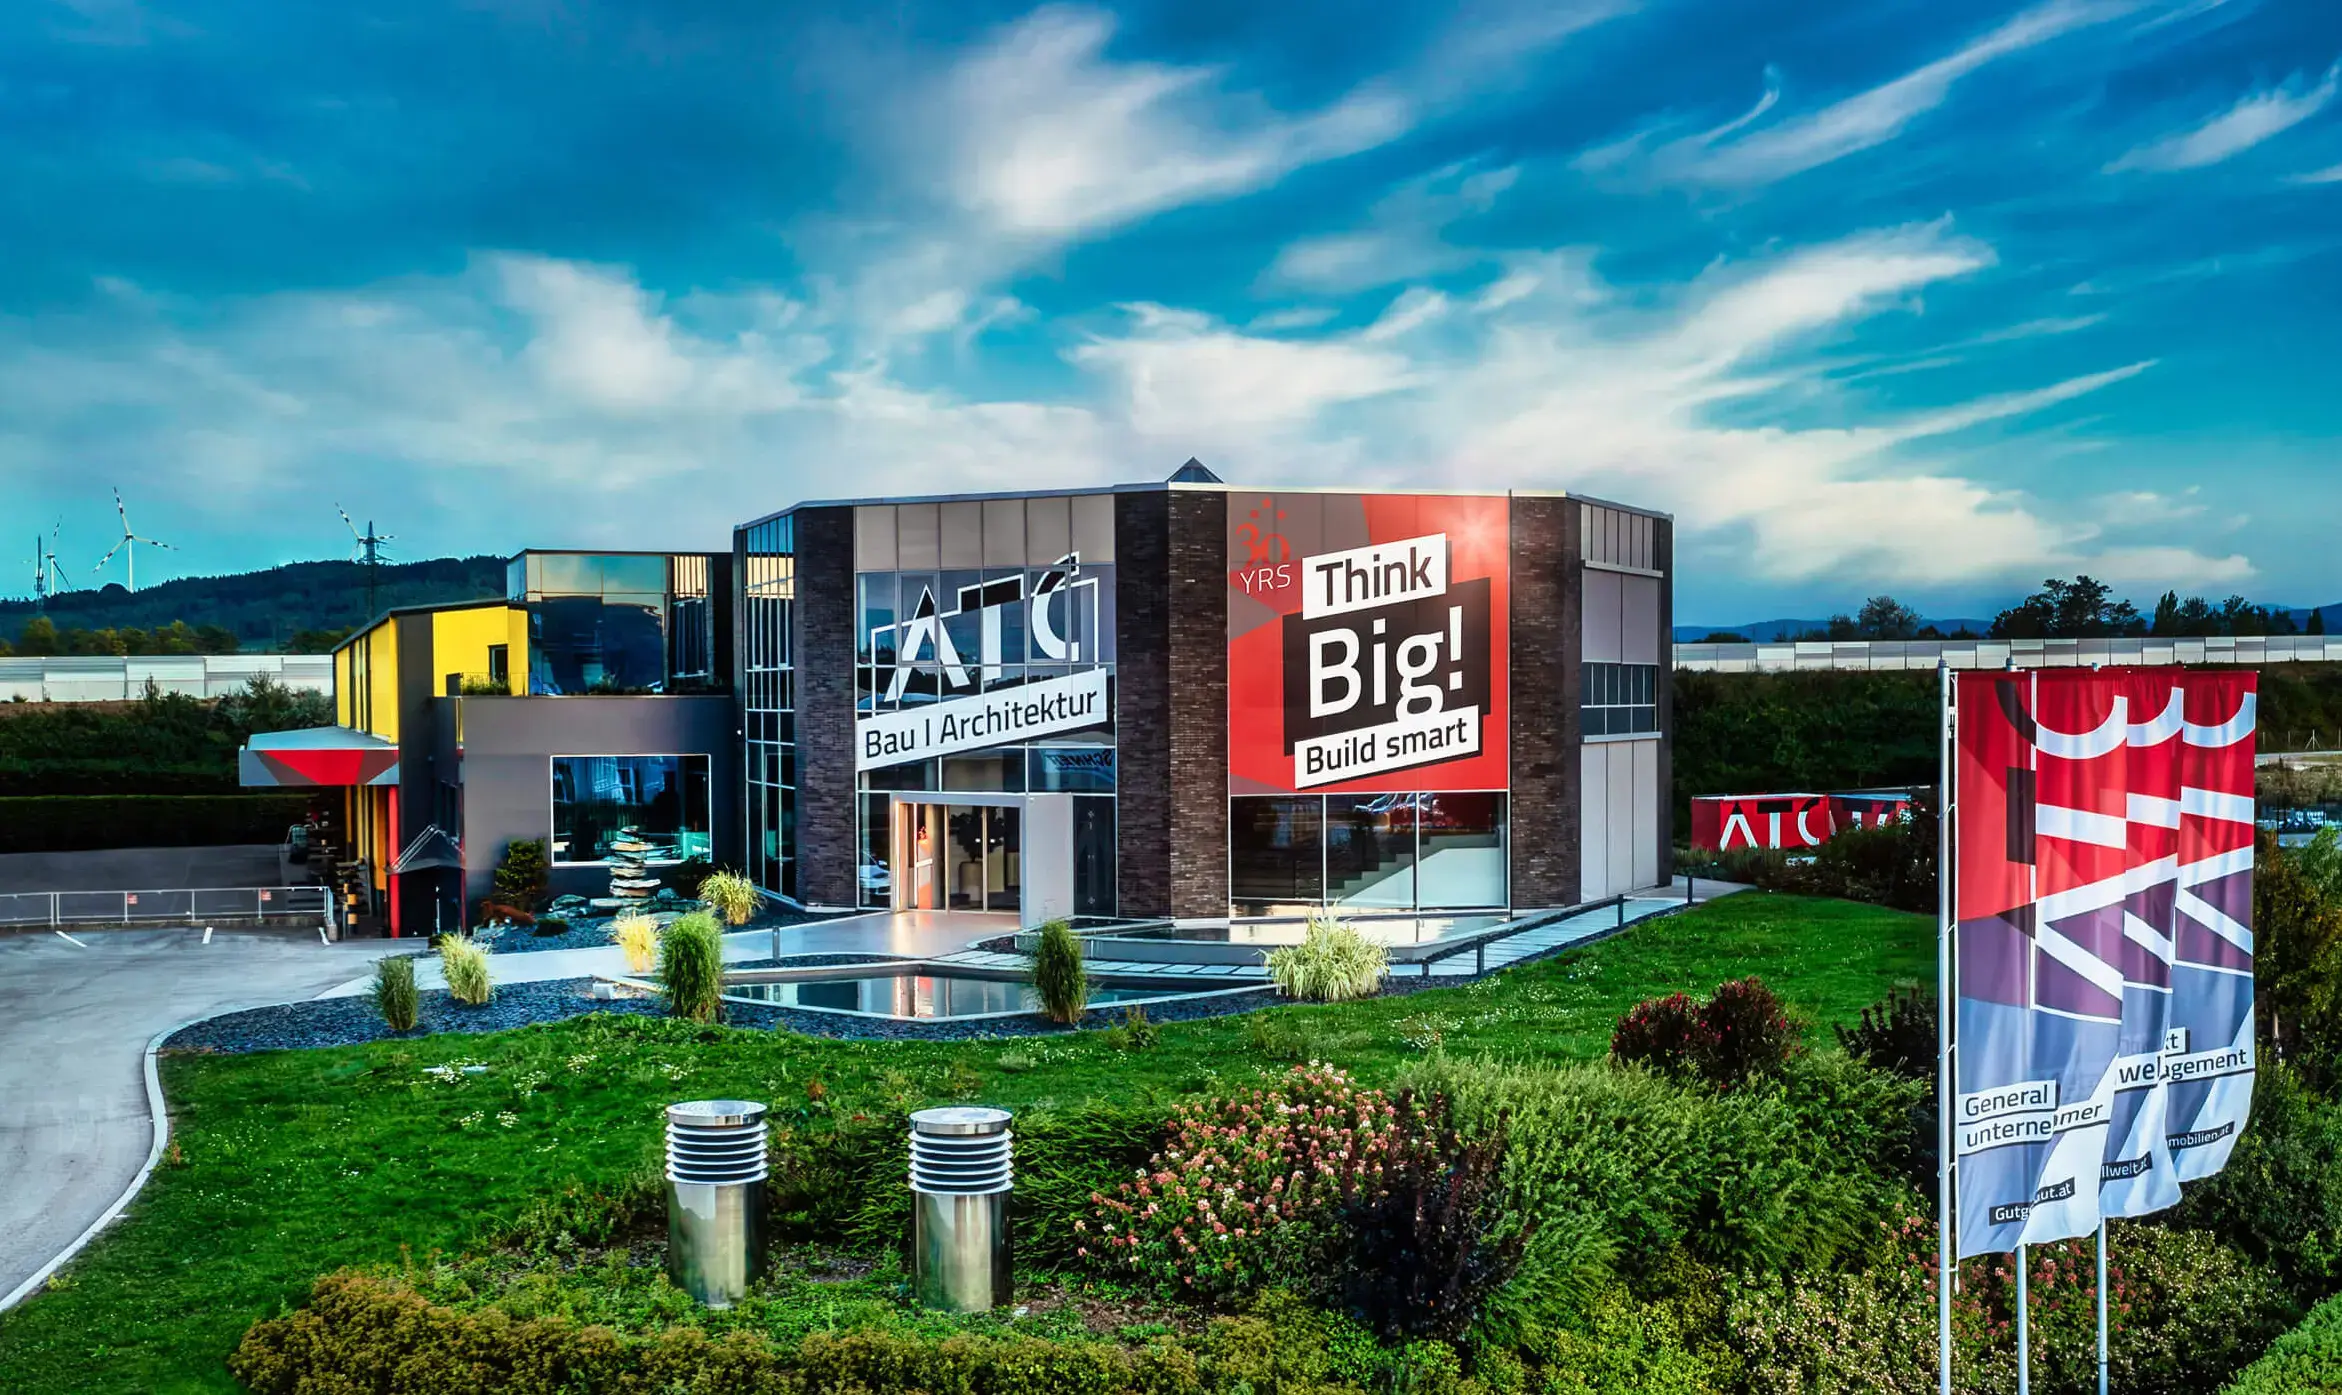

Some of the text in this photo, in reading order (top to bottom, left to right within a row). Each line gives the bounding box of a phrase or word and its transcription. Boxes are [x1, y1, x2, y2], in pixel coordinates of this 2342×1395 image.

[1240, 564, 1291, 594] YRS
[1315, 546, 1433, 607] Think
[884, 551, 1080, 702] ATC
[1309, 605, 1463, 722] Big!
[865, 728, 915, 758] Bau
[940, 690, 1098, 744] Architektur
[1306, 717, 1468, 775] Build smart
[1720, 797, 1820, 851] ATC
[1965, 1084, 2048, 1117] General
